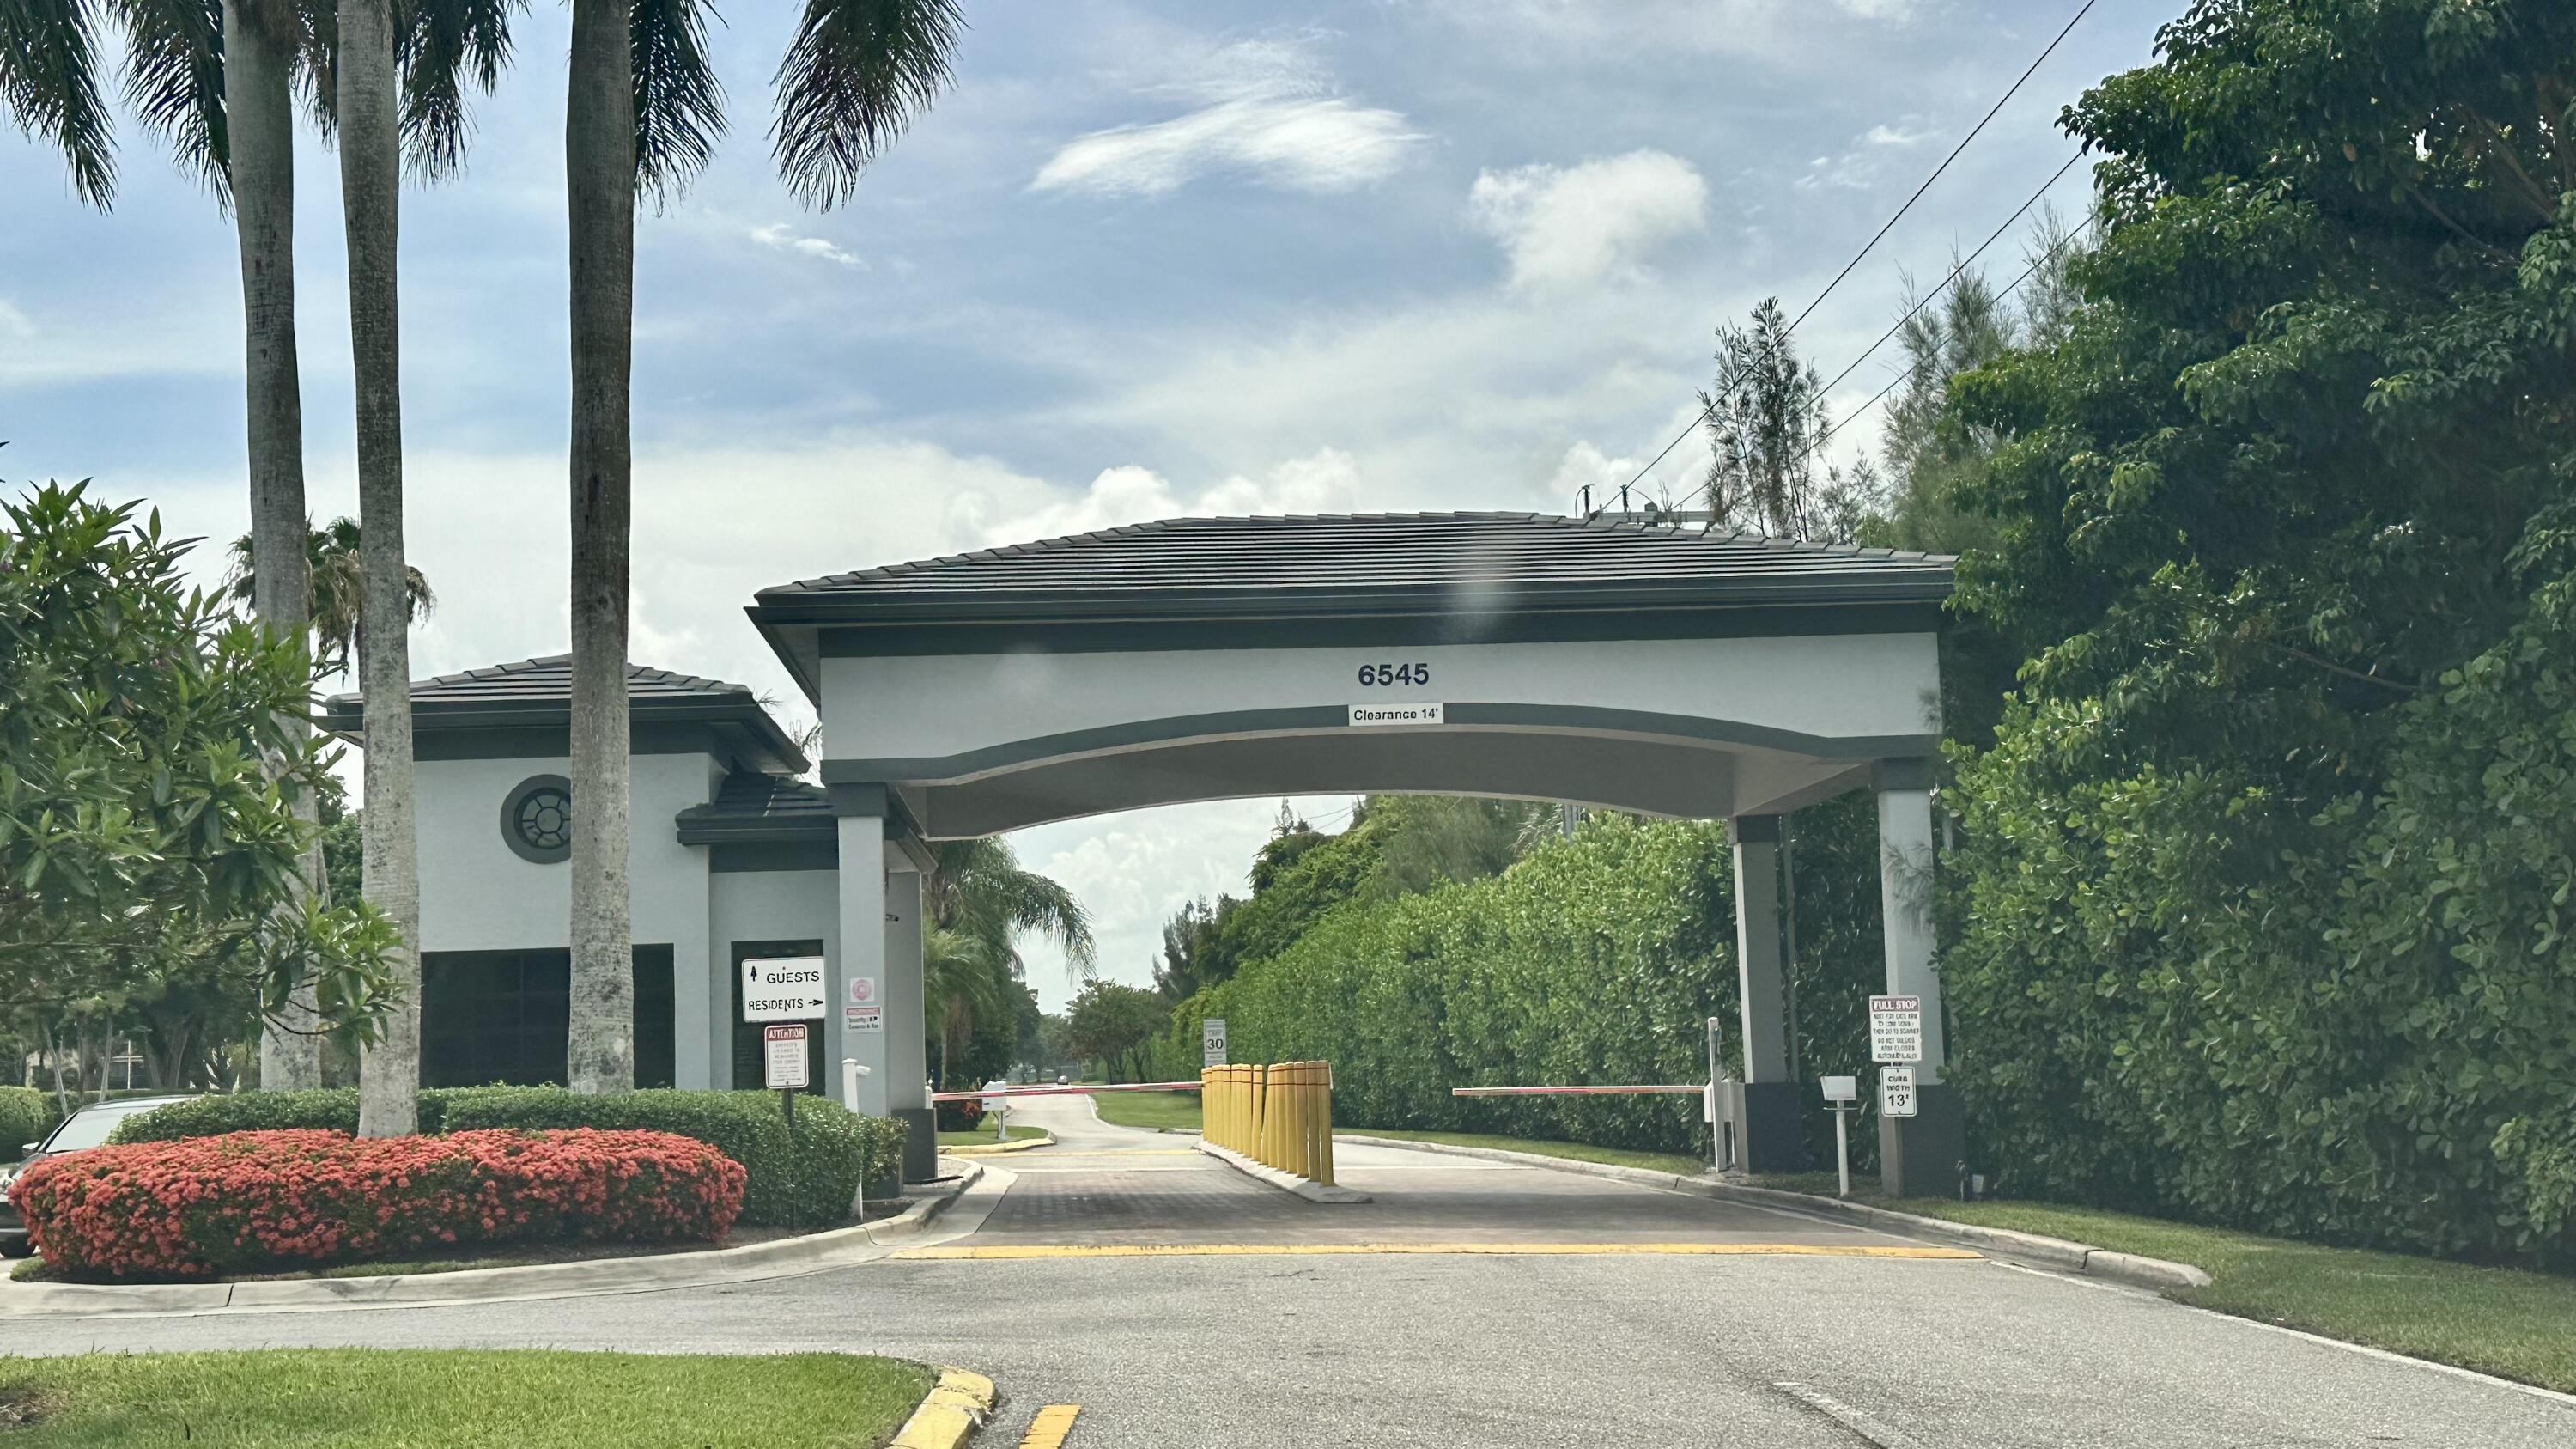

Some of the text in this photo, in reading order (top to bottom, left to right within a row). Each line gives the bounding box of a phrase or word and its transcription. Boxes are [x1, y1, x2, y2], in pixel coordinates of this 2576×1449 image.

[1358, 663, 1429, 686] 6545
[1354, 708, 1438, 721] Clearance 14'
[767, 971, 819, 983] GUESTS
[749, 998, 804, 1011] RESIDENTS
[1874, 1000, 1917, 1010] FULL STOP
[769, 1028, 804, 1038] ATTENTION
[1207, 1038, 1223, 1050] 30
[1888, 1094, 1909, 1106] 13'
